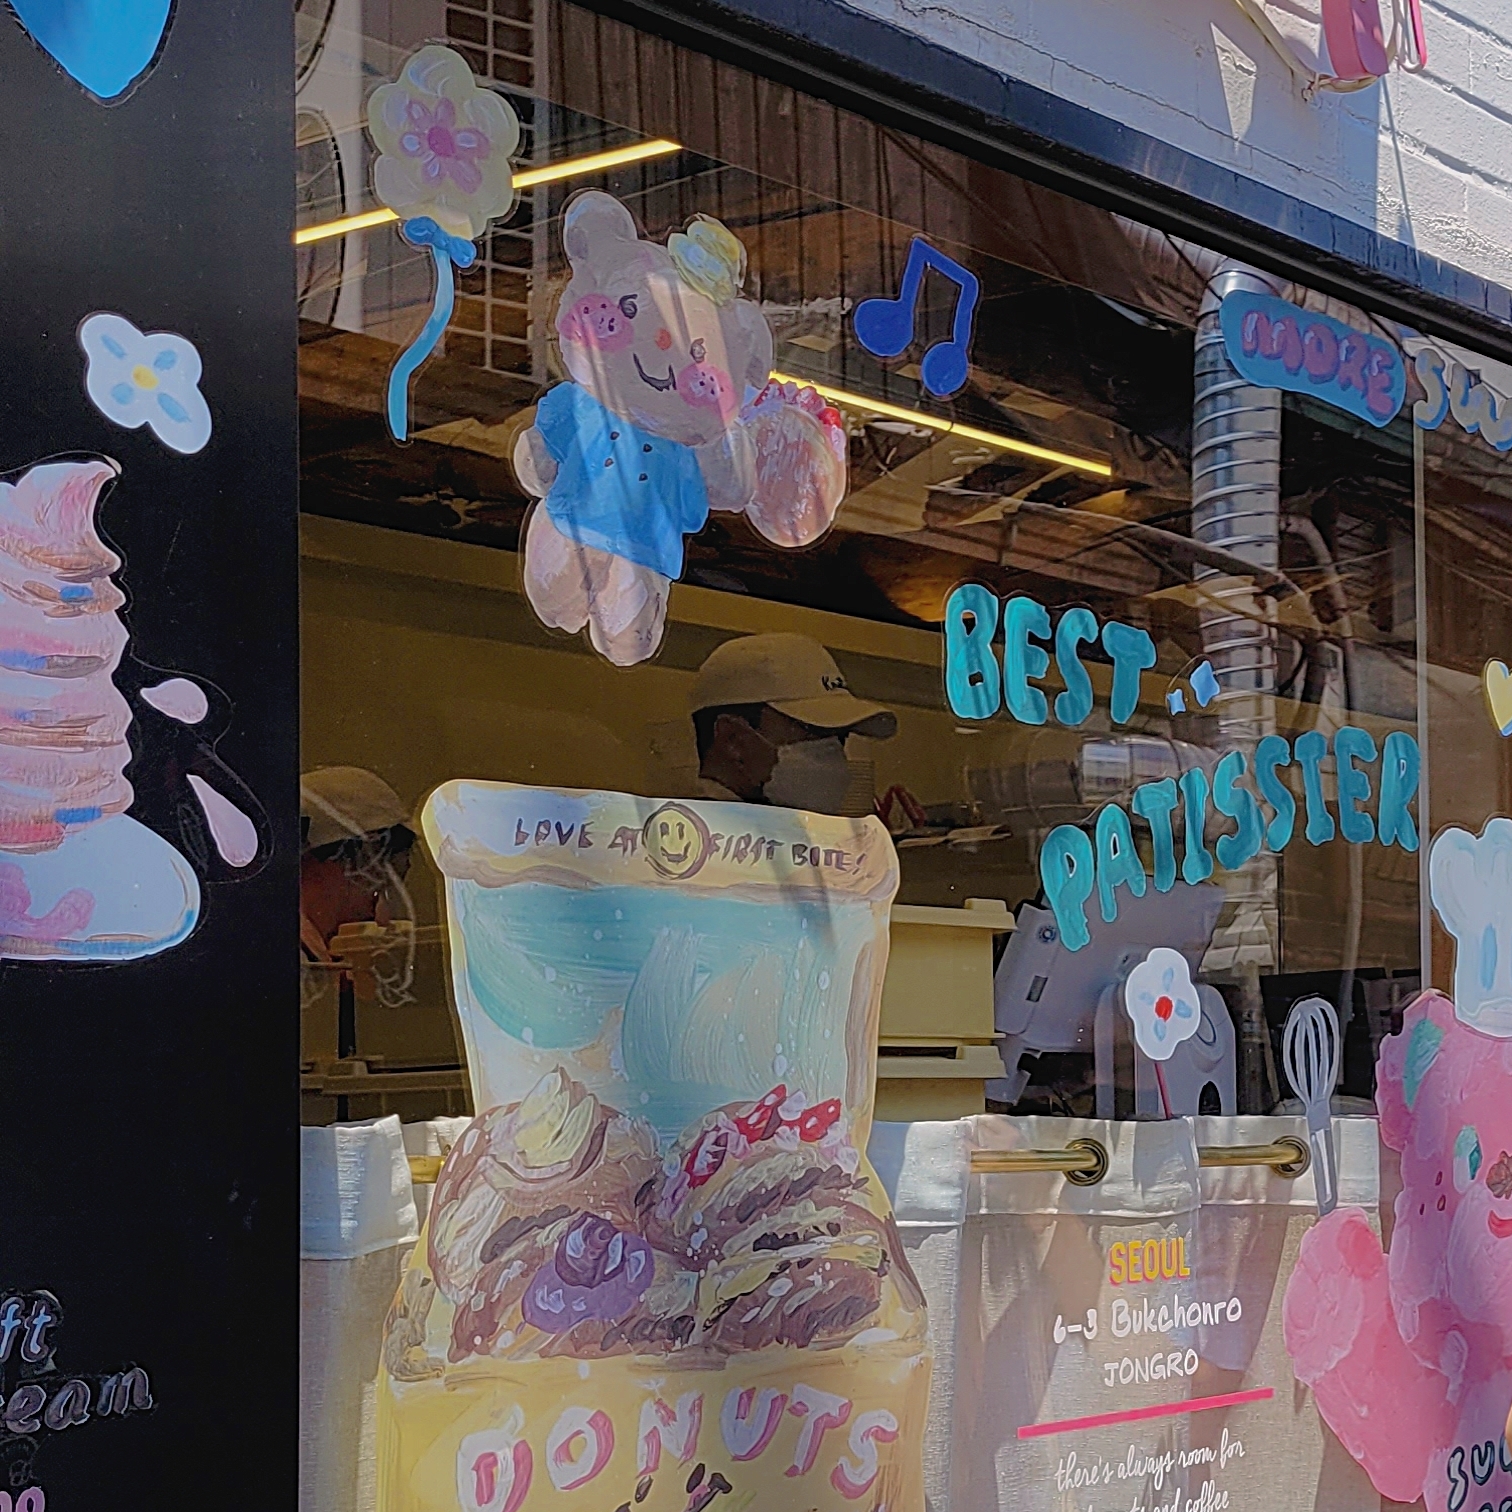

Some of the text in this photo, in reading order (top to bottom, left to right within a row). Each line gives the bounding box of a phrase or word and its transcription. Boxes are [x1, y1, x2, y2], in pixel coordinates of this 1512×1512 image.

[1240, 310, 1395, 420] MORE
[945, 583, 1157, 726] BEST
[514, 817, 595, 850] LOVE
[705, 832, 785, 864] FIRST
[1040, 725, 1421, 952] PATISSIER
[1109, 1237, 1191, 1287] SEOUL
[1053, 1293, 1242, 1344] 6-3 Bukchonro
[1103, 1348, 1199, 1387] JONGRO
[0, 1367, 153, 1434] eam
[1055, 1427, 1246, 1492] there's always room for
